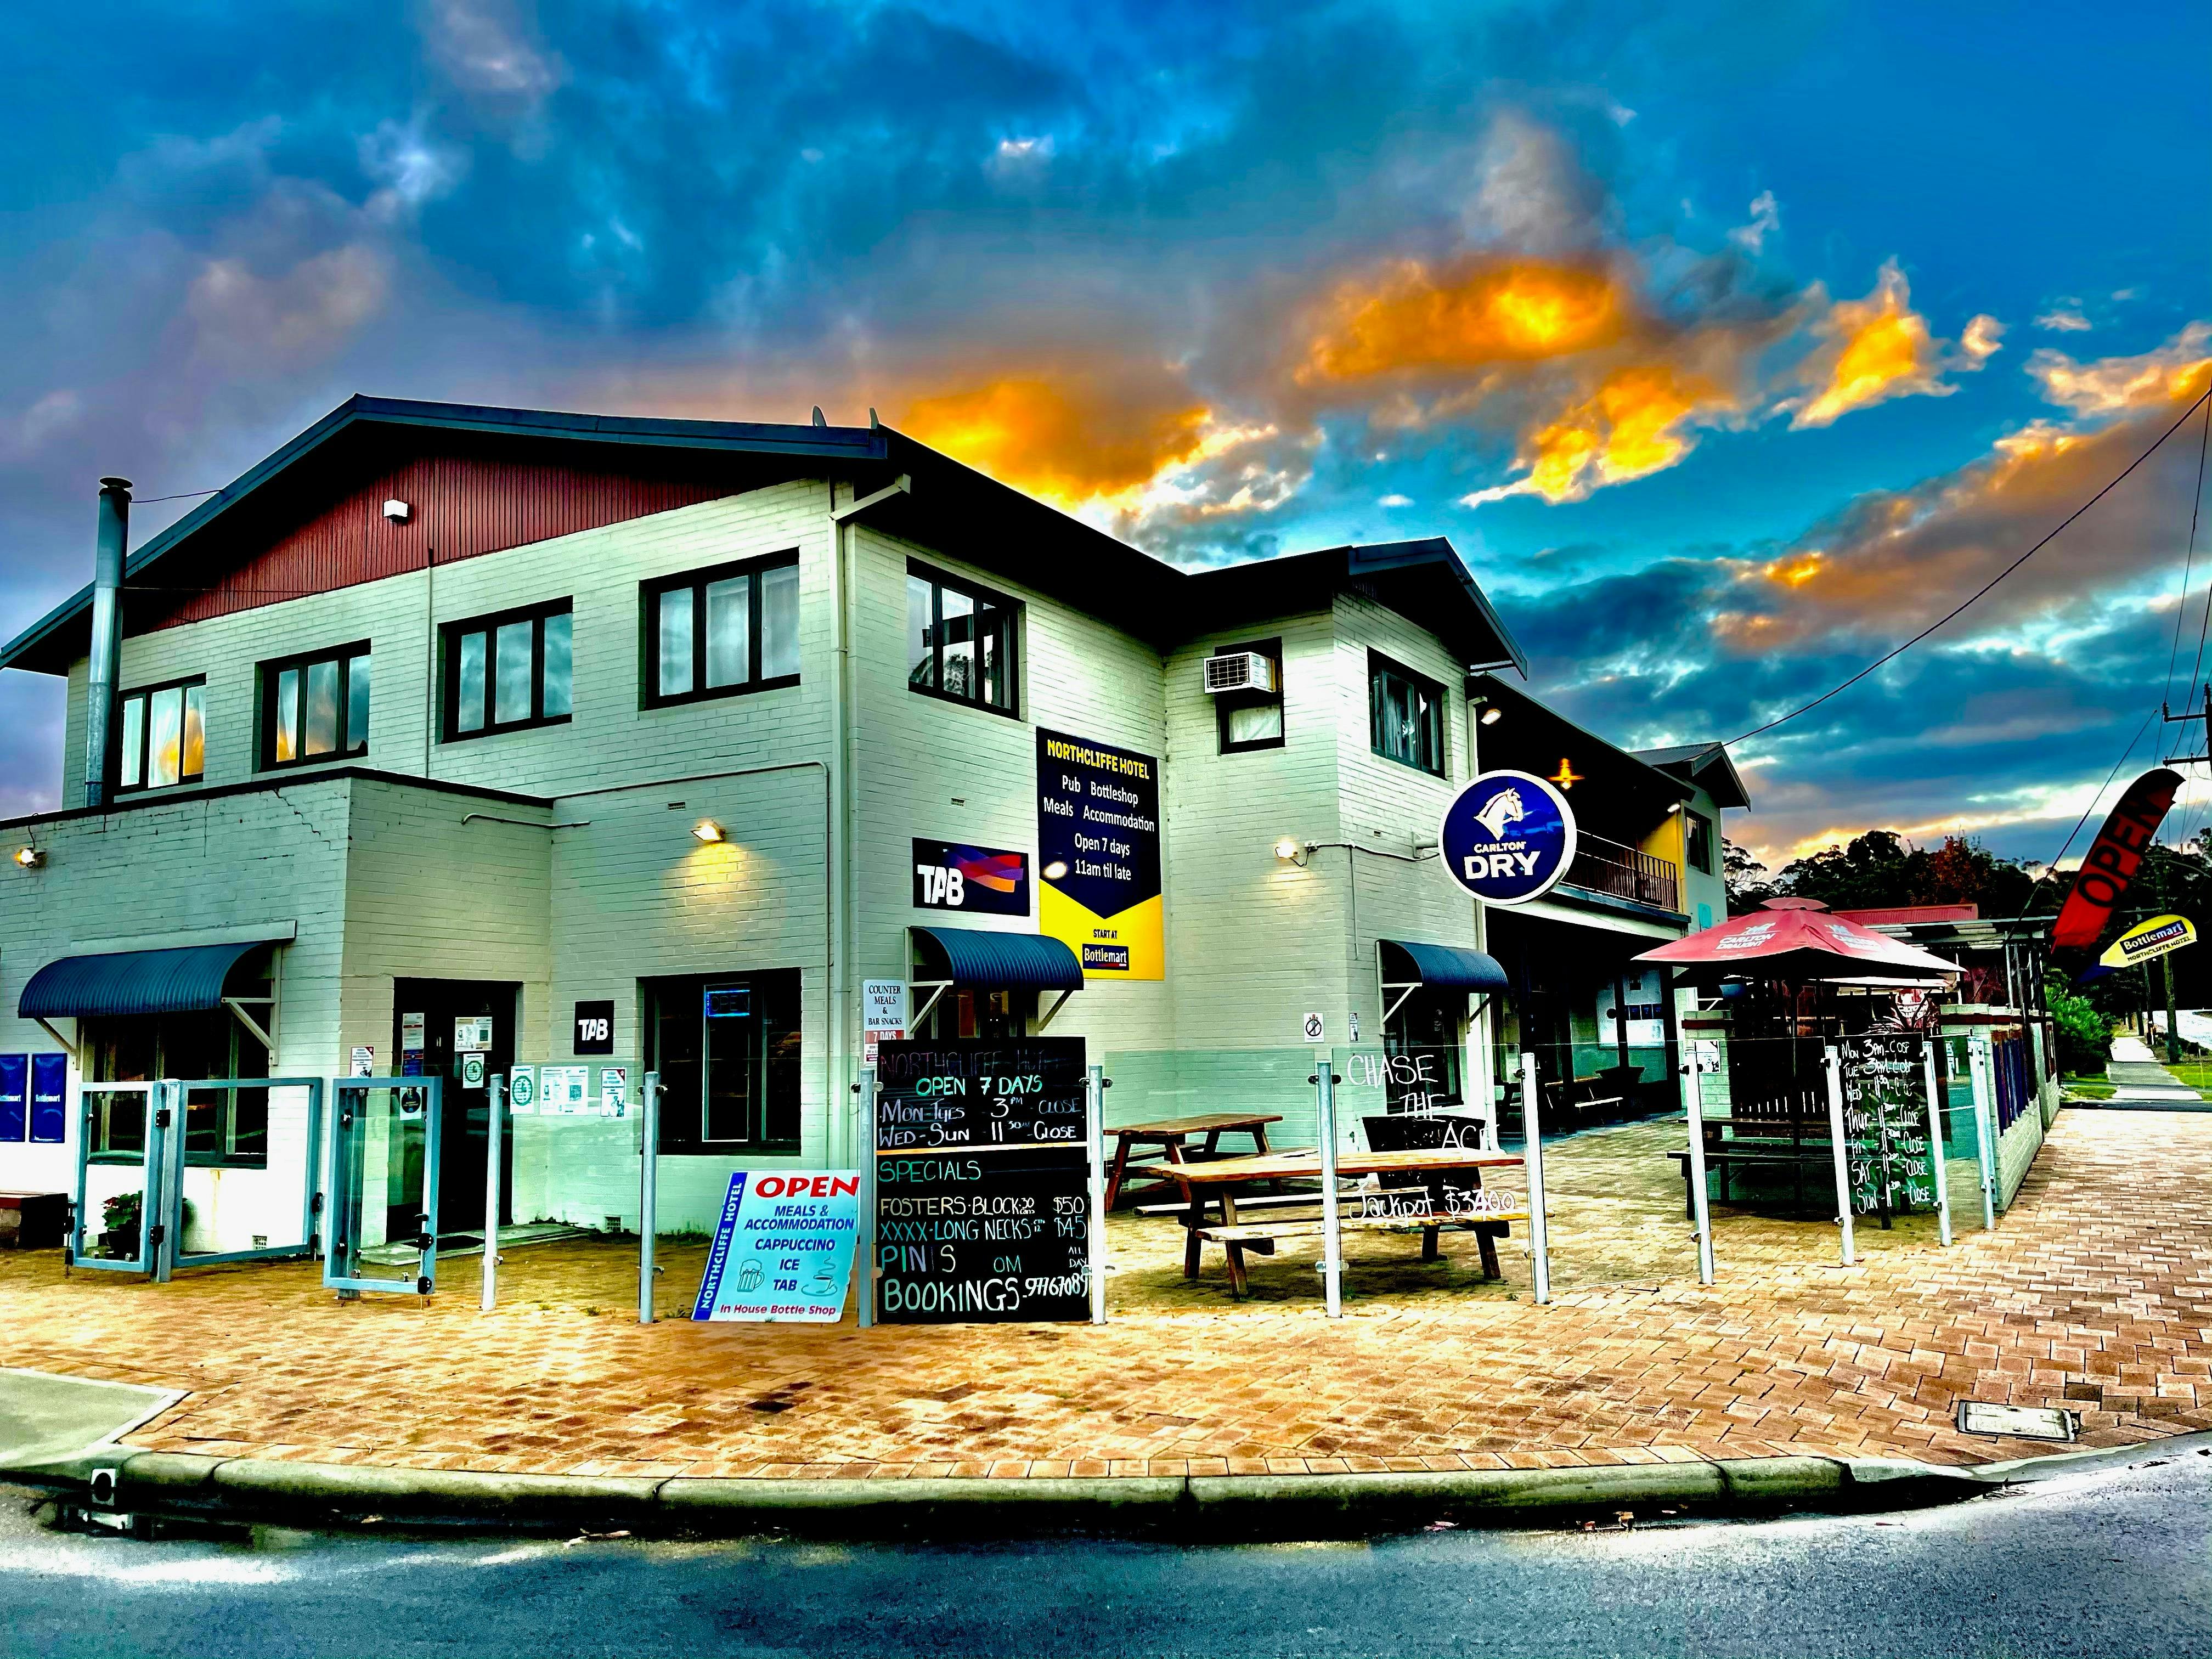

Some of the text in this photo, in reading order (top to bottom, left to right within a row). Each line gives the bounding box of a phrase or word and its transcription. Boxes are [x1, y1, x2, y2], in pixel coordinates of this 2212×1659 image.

[1047, 739, 1149, 780] NORTHCLIFFE HOTEL
[1062, 775, 1138, 808] Pub Bottleshop
[1043, 797, 1154, 832] Meals Accommodation
[1075, 833, 1130, 859] Open 7 days
[1474, 841, 1525, 854] CARLTON
[2078, 790, 2164, 907] OPEN
[1075, 859, 1131, 881] 11am til late
[1464, 851, 1541, 879] DRY
[917, 865, 964, 906] TAB
[1093, 929, 1118, 939] START AT
[1719, 933, 1775, 944] CARLTON
[2124, 923, 2183, 950] Bottlemart
[1084, 947, 1127, 963] Bottlemart
[2128, 936, 2191, 961] NORTHCLIFFE HOTEL
[869, 985, 901, 994] COUNTER
[874, 996, 896, 1005] MEALS
[578, 1019, 608, 1041] TAB
[873, 1031, 896, 1042] 7 DAYS
[1347, 1054, 1438, 1089] CHASE
[916, 1075, 1042, 1096] OPEN 7 DAYS
[1400, 1092, 1446, 1122] THE
[878, 1161, 981, 1182] SPECIALS
[755, 1176, 860, 1198] OPEN
[725, 1182, 742, 1222] HOTEL
[774, 1204, 829, 1217] MEALS &
[1053, 1197, 1085, 1215] $50
[1348, 1181, 1435, 1227] Jackpot
[744, 1218, 855, 1231] ACCOMMODATION
[985, 1218, 1031, 1240] NECKS
[1054, 1216, 1086, 1239] $45
[755, 1238, 836, 1251] CAPPUCCINO
[701, 1227, 731, 1310] NORTHCLIFFE
[779, 1259, 800, 1271] ICE
[1069, 1257, 1087, 1268] DAY
[773, 1279, 798, 1291] TAB
[884, 1277, 1019, 1312] BOOKINGS
[720, 1304, 836, 1316] In House Bottle Shop
